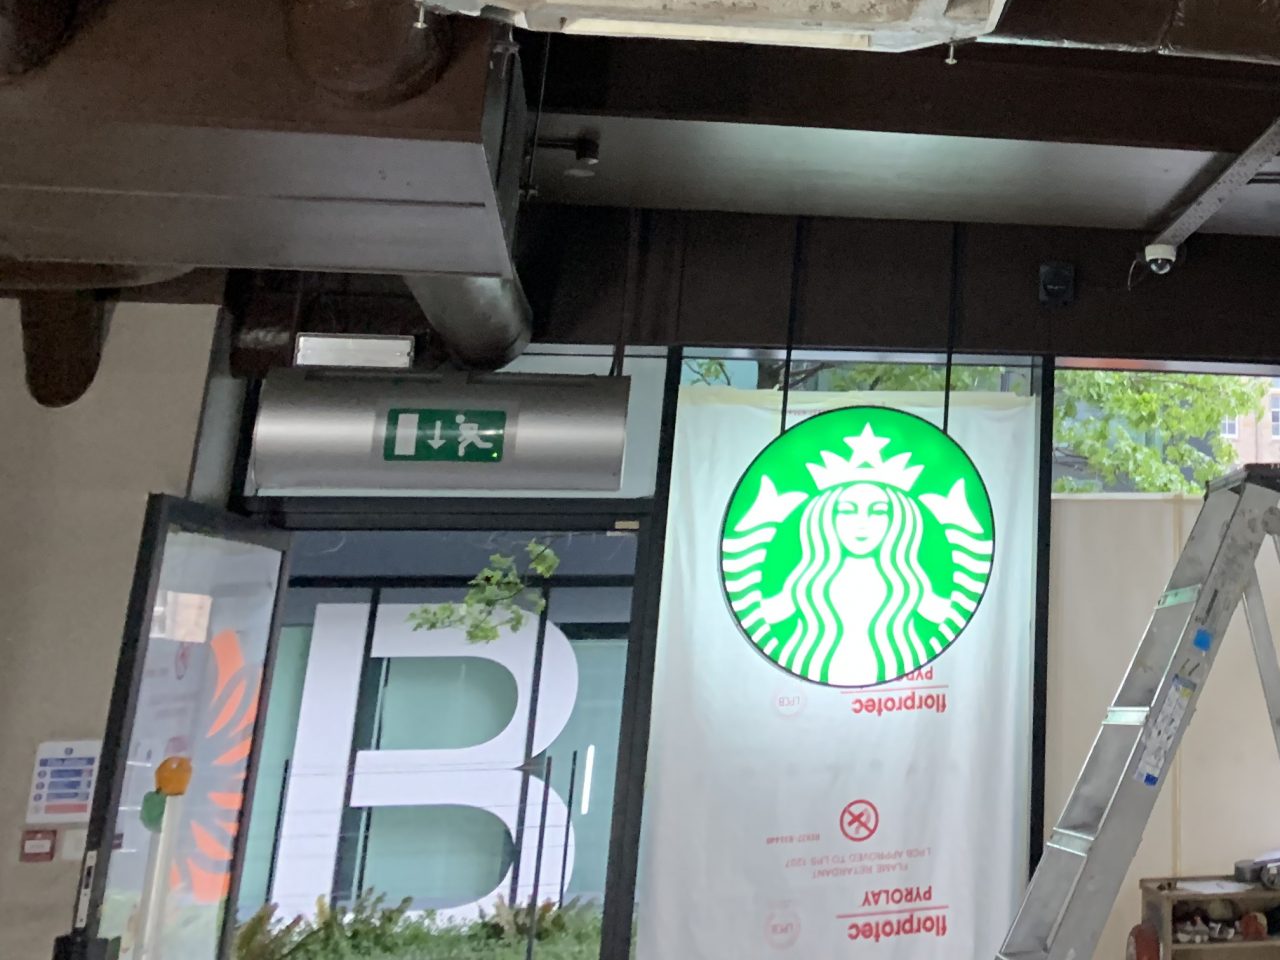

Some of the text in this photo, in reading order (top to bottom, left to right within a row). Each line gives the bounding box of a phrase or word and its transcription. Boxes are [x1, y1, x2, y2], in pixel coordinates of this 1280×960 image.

[851, 691, 946, 716] florprotec
[831, 854, 846, 864] TO
[849, 850, 903, 862] APPROVED
[812, 862, 908, 879] FLAME RETARDANT
[861, 886, 932, 906] PYROLAY
[847, 913, 947, 942] florprotec
